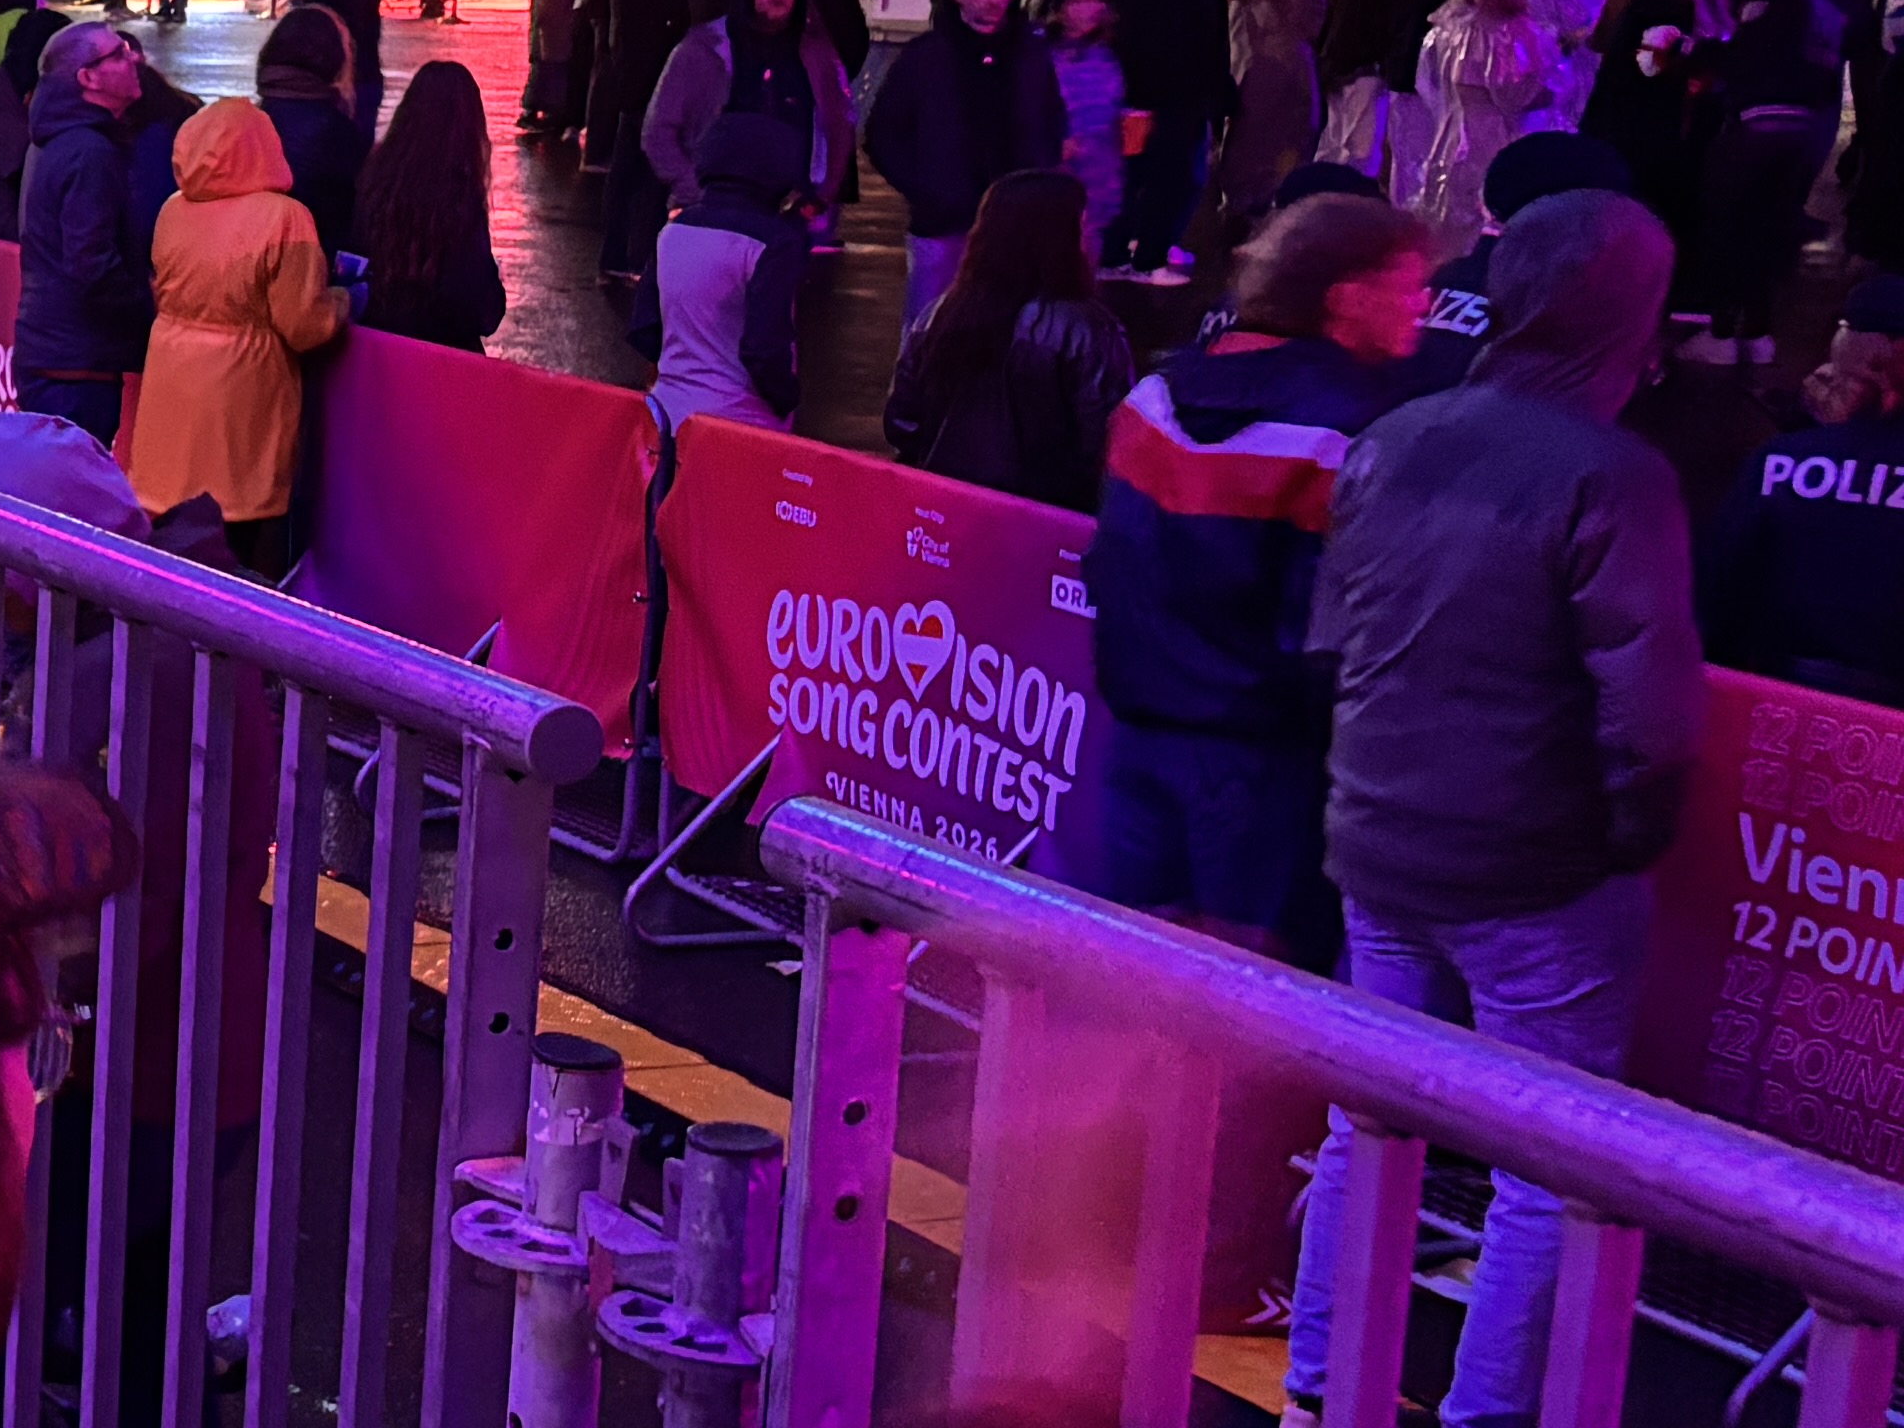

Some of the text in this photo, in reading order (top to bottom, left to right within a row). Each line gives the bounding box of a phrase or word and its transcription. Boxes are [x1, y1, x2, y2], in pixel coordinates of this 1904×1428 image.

[1052, 581, 1085, 607] OR
[768, 672, 1072, 832] SONG CONTEST
[1748, 702, 1792, 756] 12
[825, 770, 1000, 863] VIENNA 2026
[1738, 811, 1904, 925] Vien
[1732, 899, 1778, 952] 12
[1722, 953, 1772, 1010] 12
[1706, 1009, 1761, 1063] 12
